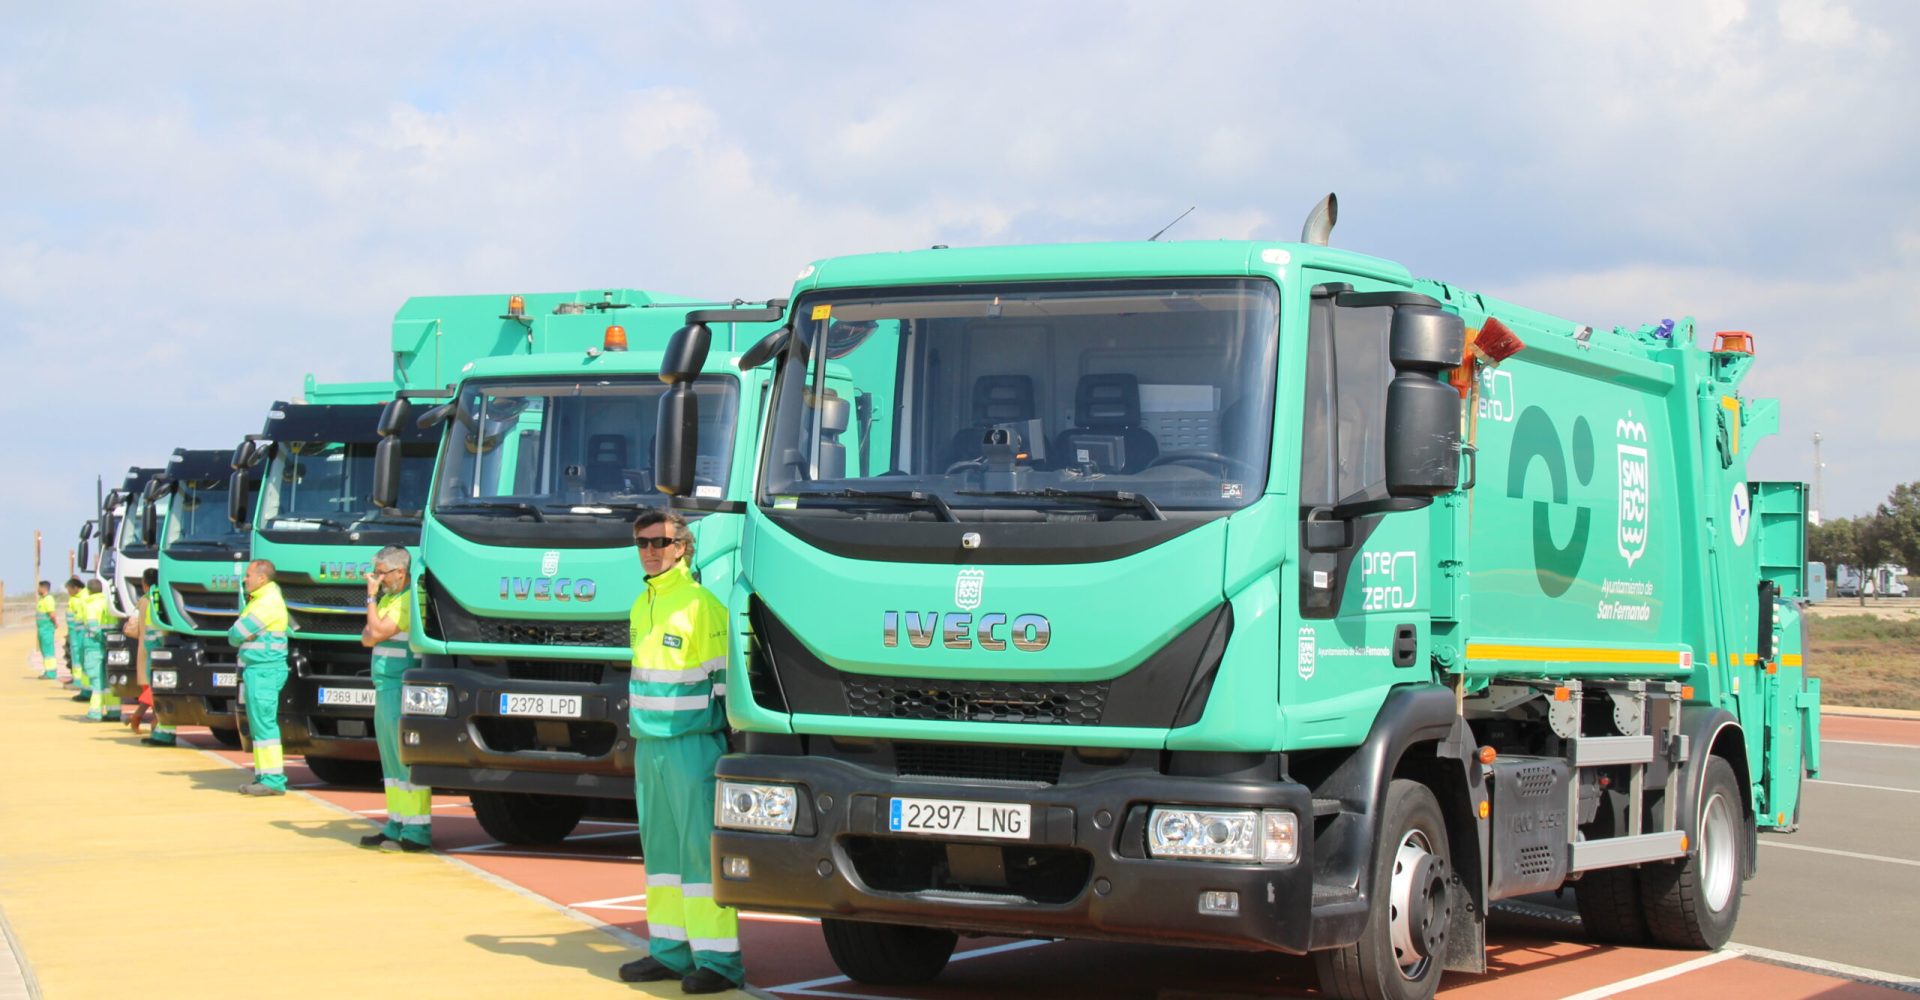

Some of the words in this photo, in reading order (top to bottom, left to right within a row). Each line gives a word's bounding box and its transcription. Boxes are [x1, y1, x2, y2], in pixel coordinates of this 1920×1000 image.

[1477, 397, 1502, 420] ero
[1622, 459, 1645, 489] SAN
[319, 560, 371, 579] IVEC
[1361, 551, 1391, 582] pre
[499, 577, 597, 603] IVECO
[1361, 586, 1402, 610] zero
[1601, 577, 1644, 598] Ayuntamiento
[1597, 600, 1613, 619] San
[1613, 601, 1650, 621] Fernando
[882, 611, 1052, 652] IVECO
[326, 690, 352, 703] 7369
[510, 697, 545, 713] 2378
[550, 698, 577, 715] LPD
[907, 804, 966, 829] 2297
[976, 806, 1022, 833] LNG
